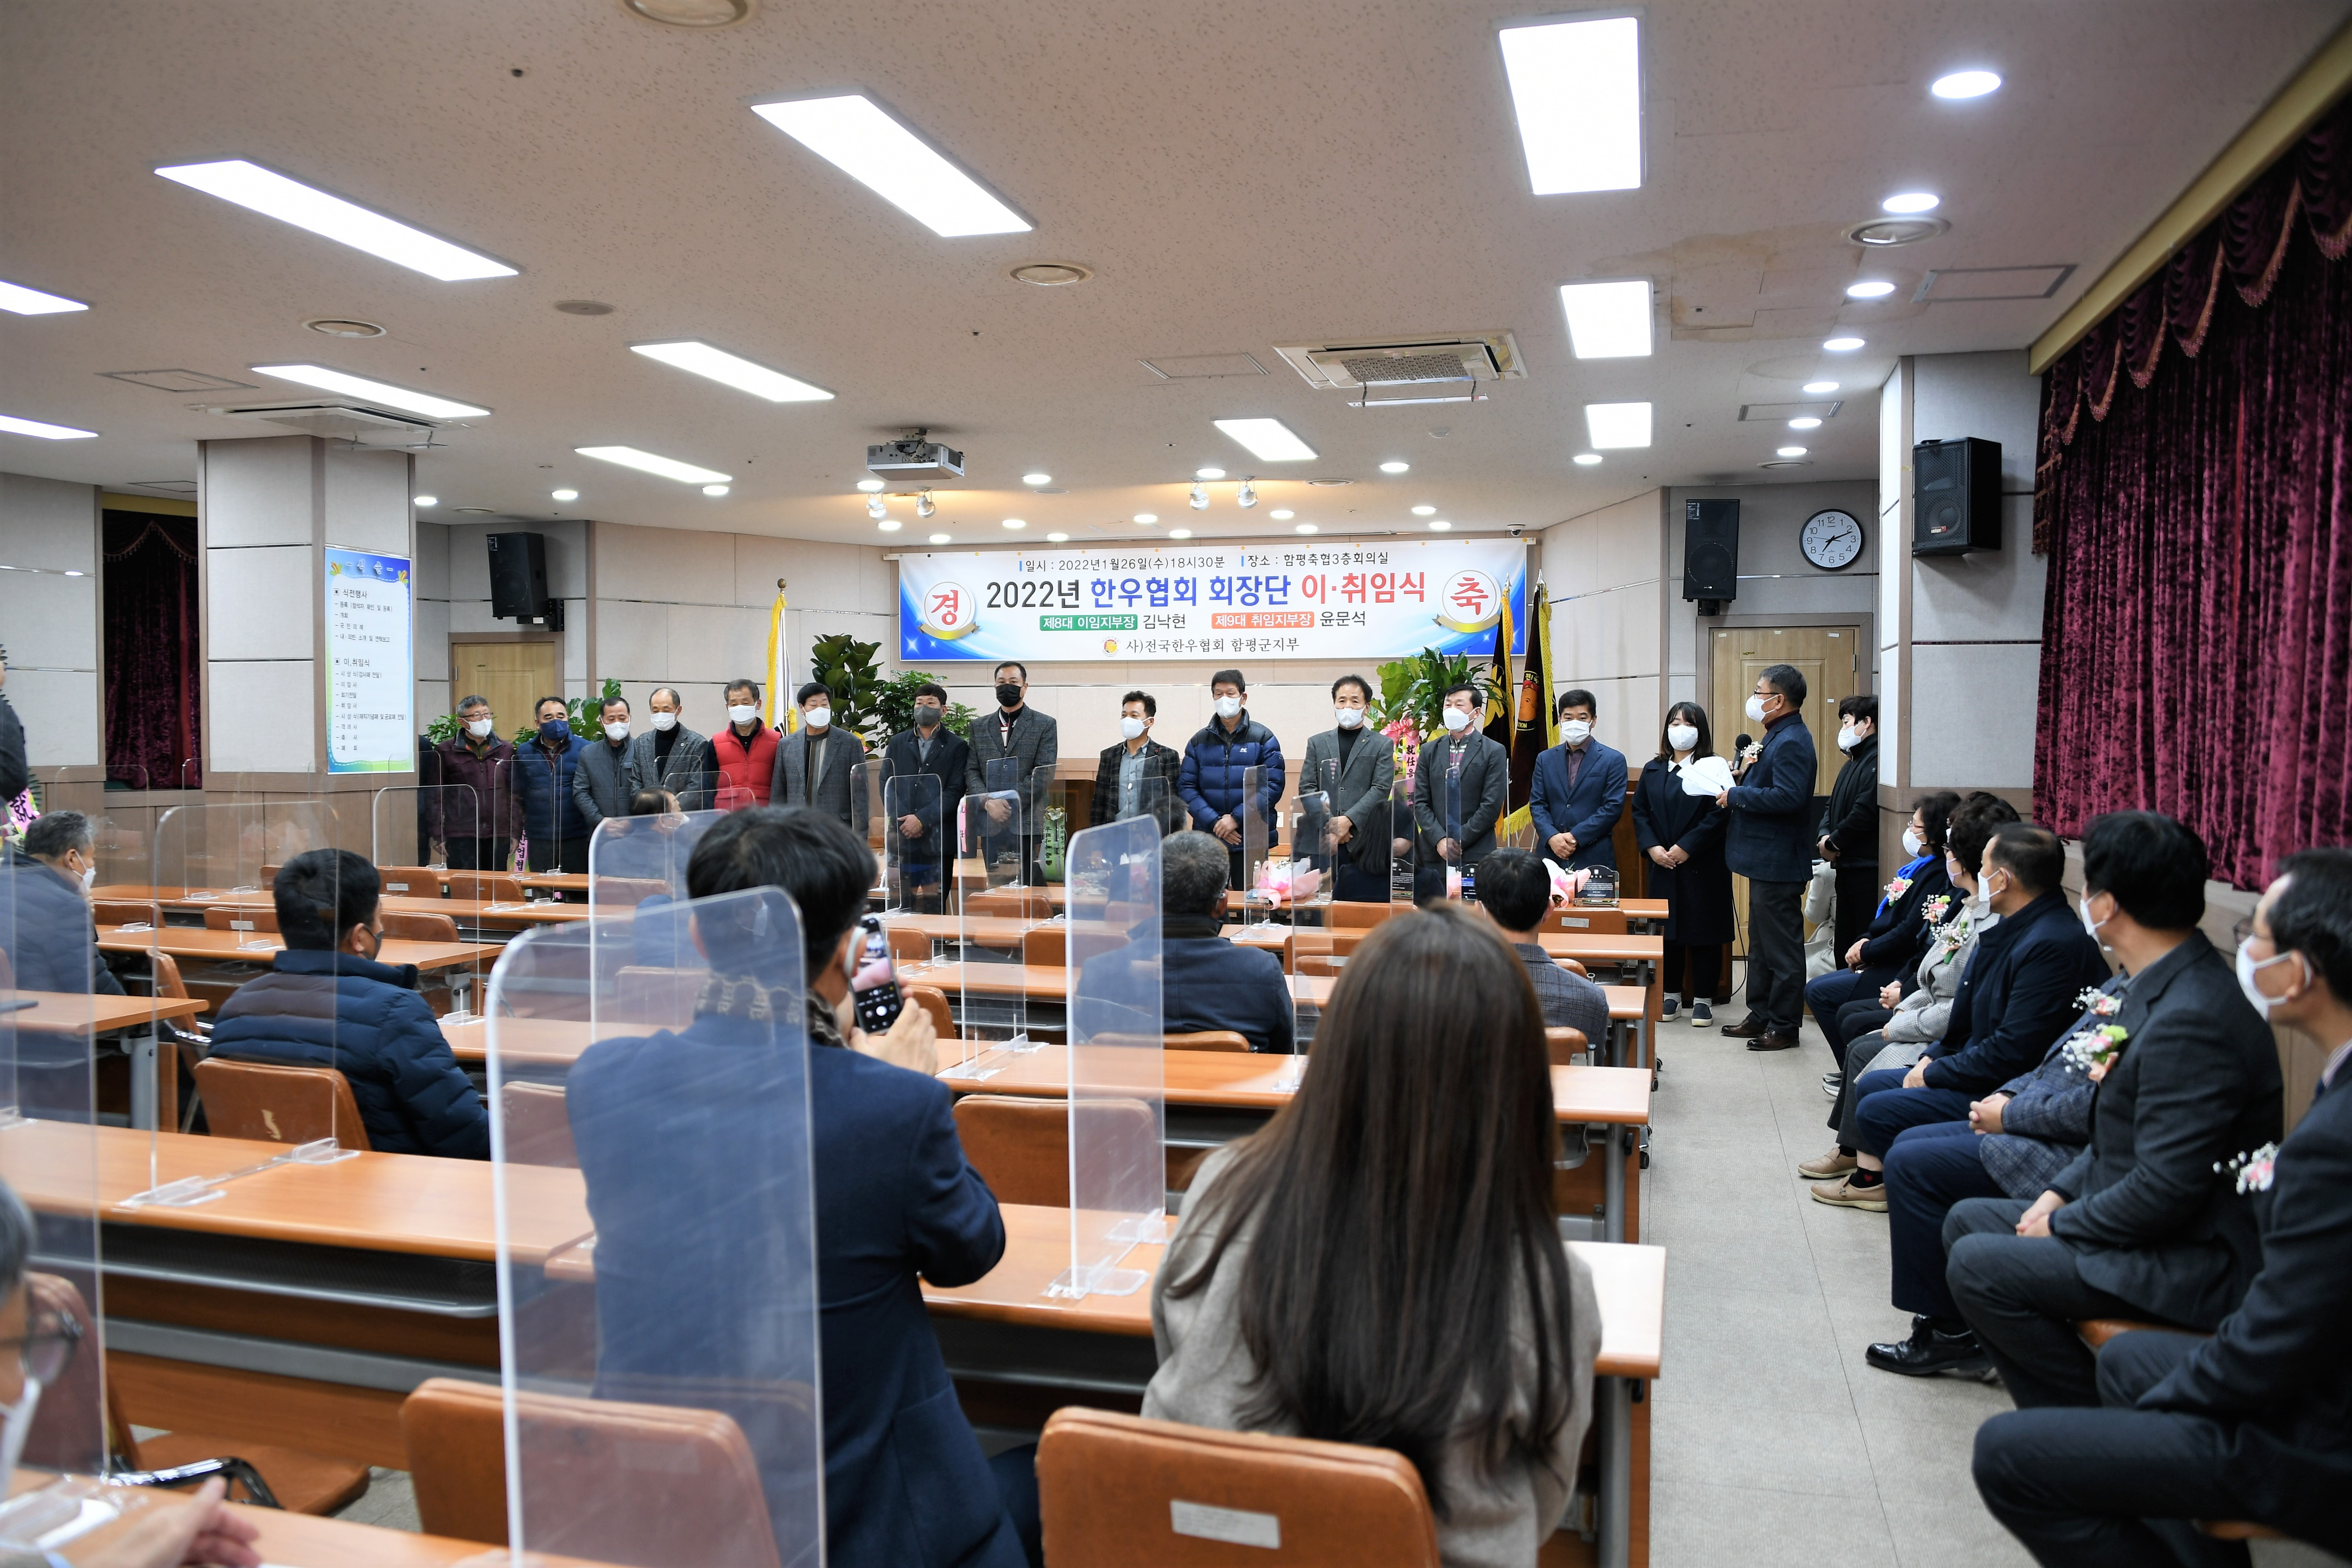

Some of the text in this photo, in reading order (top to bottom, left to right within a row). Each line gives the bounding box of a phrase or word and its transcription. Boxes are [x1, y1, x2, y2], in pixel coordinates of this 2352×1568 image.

[1025, 560, 1046, 572] 일시
[1059, 556, 1225, 571] 2022년1월26일(수)18시30분
[1247, 555, 1271, 567] 장소
[1284, 552, 1389, 566] 함평축협3층회의실
[343, 588, 367, 599] 식전행사
[986, 572, 1424, 608] 2022년 한우협회 회장단 이·취임식
[1450, 577, 1489, 615] 축
[931, 590, 958, 625] 경
[1043, 616, 1135, 629] 제8대 이임지부장
[1142, 614, 1186, 629] 김낙현
[1215, 613, 1312, 627] 제9대 취임지부장
[1319, 611, 1366, 627] 윤문석
[1126, 638, 1224, 653] 사)전국한우협회
[1230, 637, 1300, 652] 함평군지부
